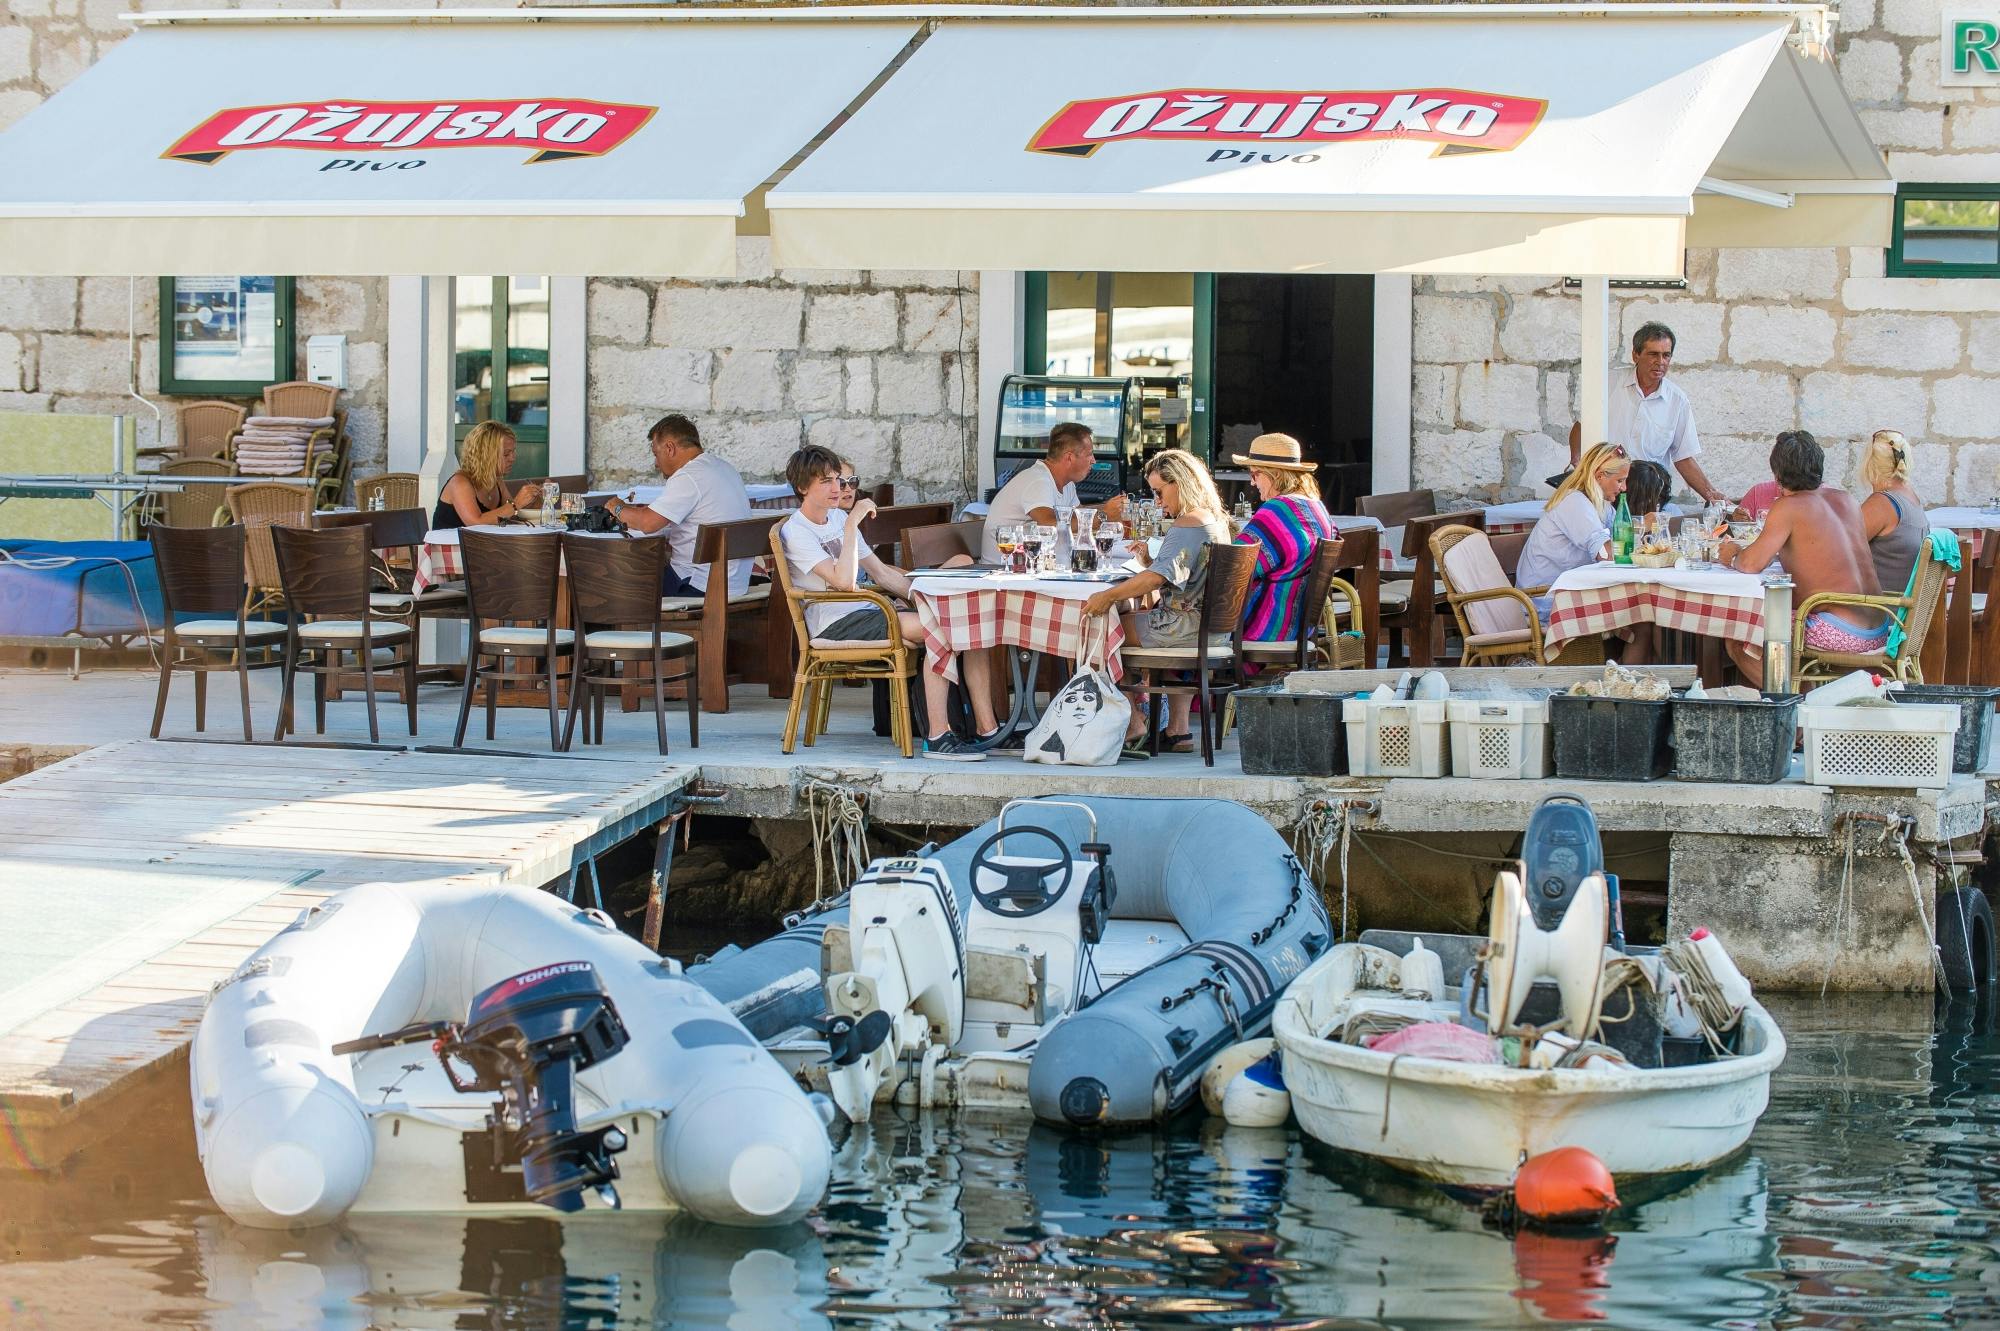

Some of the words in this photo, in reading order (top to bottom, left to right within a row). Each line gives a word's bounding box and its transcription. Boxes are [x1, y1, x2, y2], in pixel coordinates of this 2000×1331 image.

[1952, 20, 2000, 73] R
[217, 103, 608, 147] Ožujsko
[1082, 94, 1500, 138] Ožujsko
[1206, 149, 1321, 163] Pivo
[515, 962, 592, 986] TOHATSU
